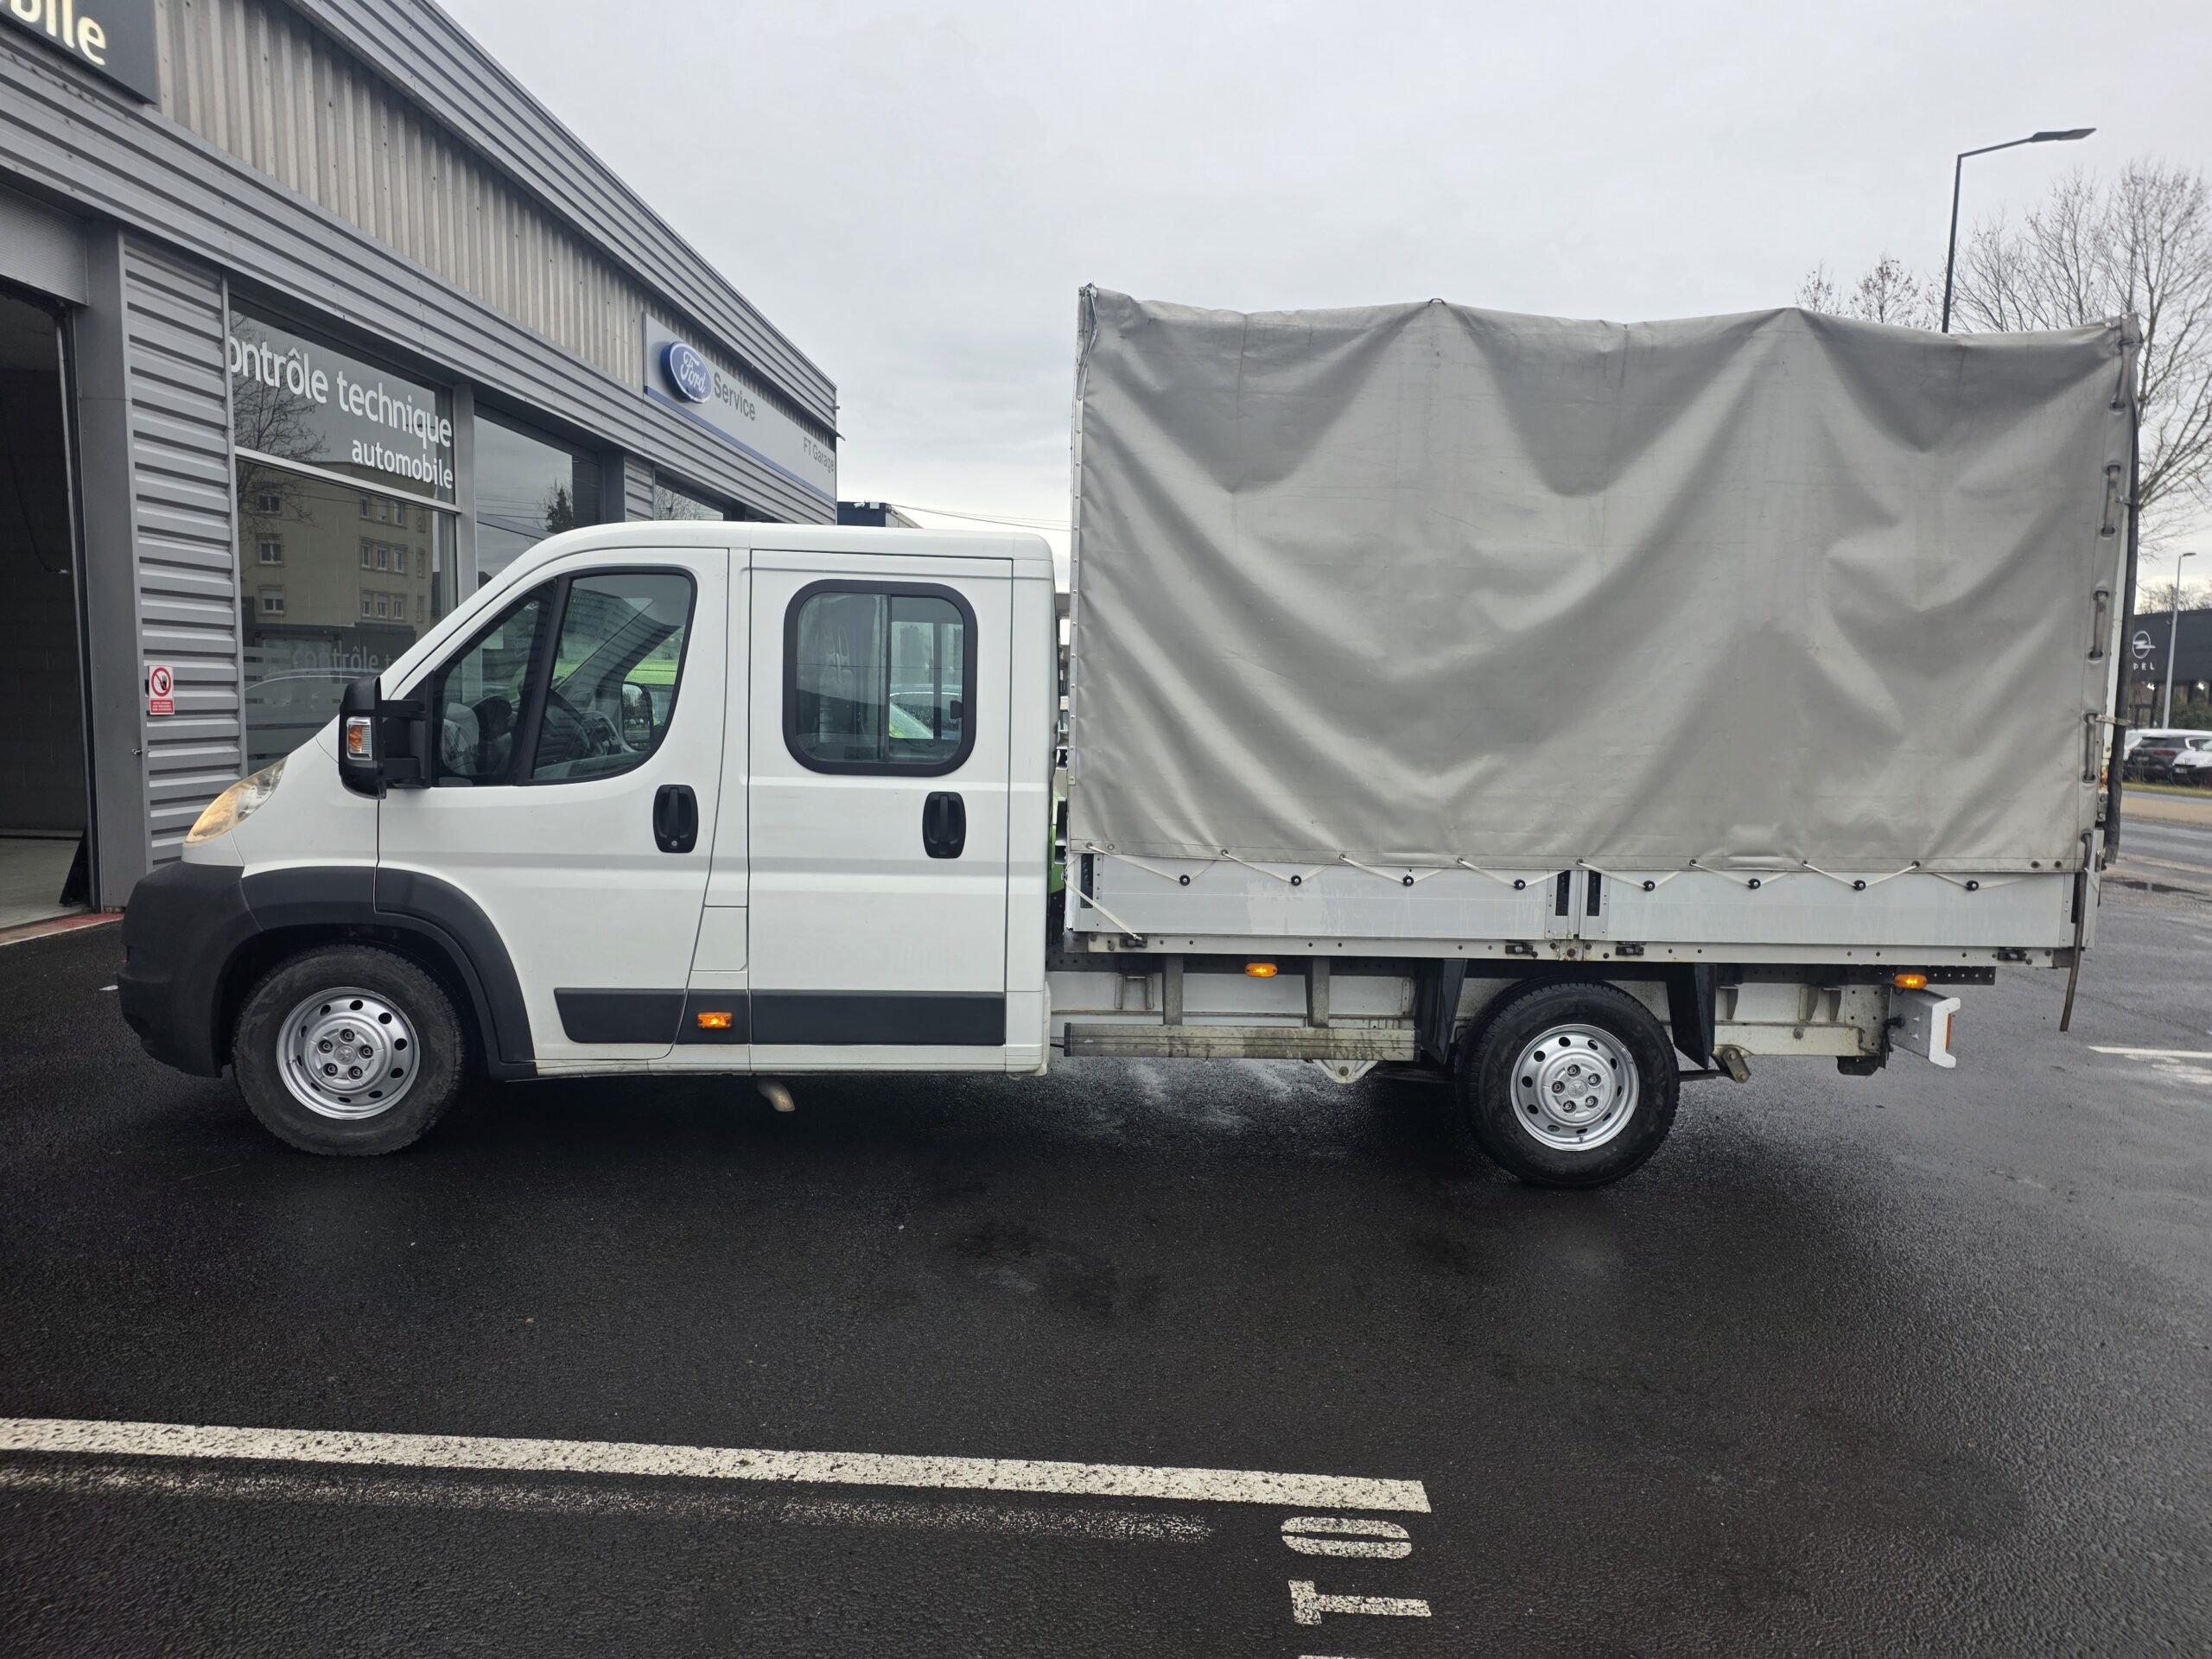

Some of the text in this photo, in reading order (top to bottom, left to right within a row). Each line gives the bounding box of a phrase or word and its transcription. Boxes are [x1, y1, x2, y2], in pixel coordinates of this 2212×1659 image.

[229, 335, 453, 449] ontrôle technique
[680, 350, 756, 422] Ford Service
[351, 439, 454, 489] automobile
[803, 436, 835, 473] FT Garage
[2133, 661, 2155, 671] PEL
